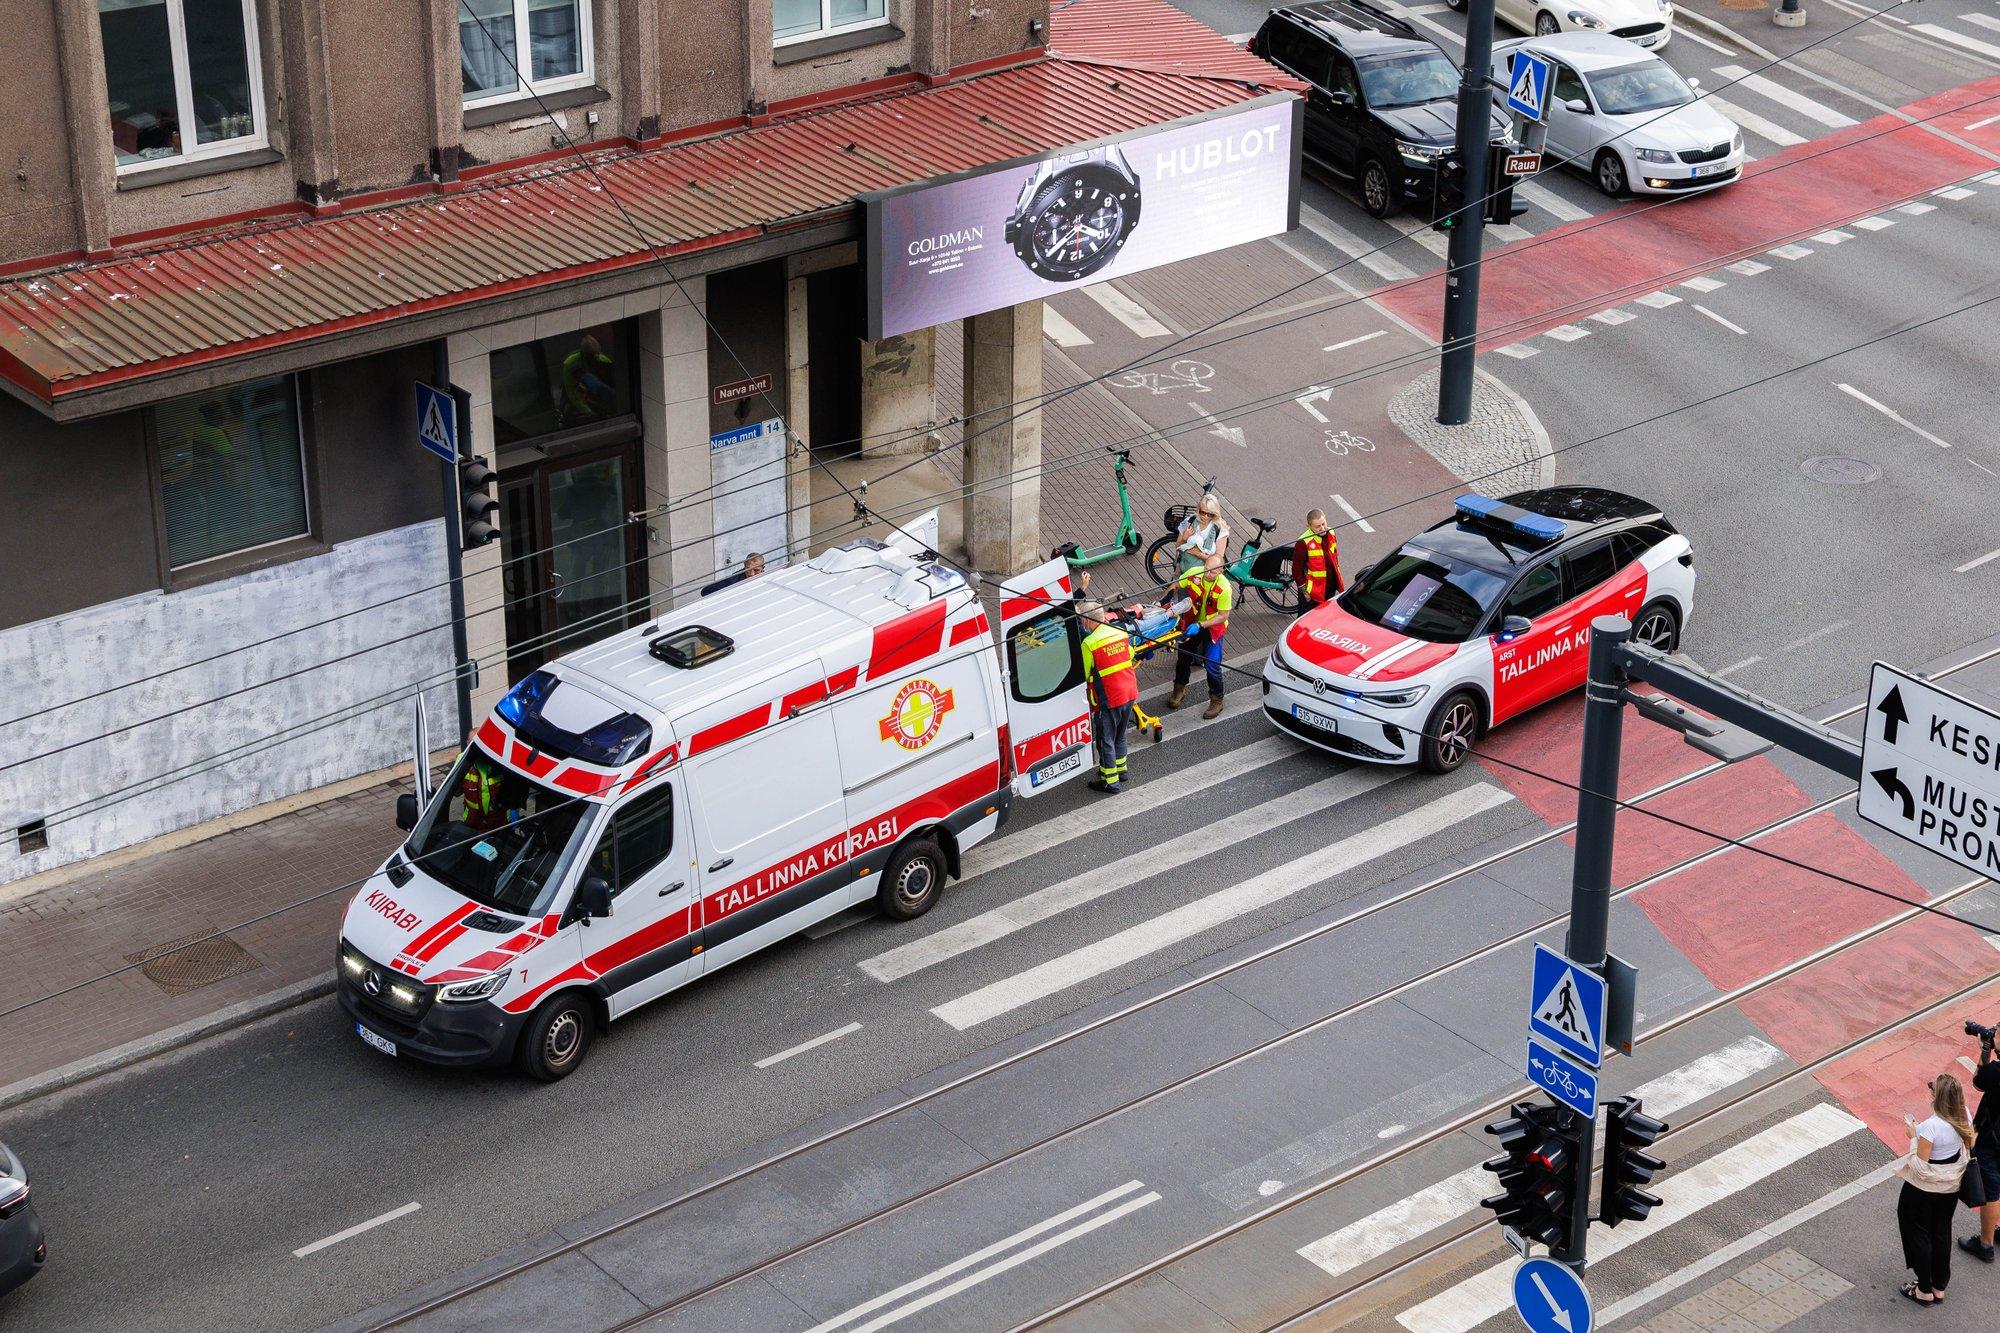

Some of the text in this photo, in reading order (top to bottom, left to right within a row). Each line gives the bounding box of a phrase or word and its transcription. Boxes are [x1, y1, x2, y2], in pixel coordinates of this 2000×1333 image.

[1156, 124, 1281, 181] HUBLOT
[1510, 160, 1536, 171] Raua
[908, 225, 983, 256] GOLDMAN
[720, 379, 767, 399] Narva mnt
[710, 422, 780, 450] Narva mnt 14
[1499, 648, 1516, 662] ARST
[1500, 637, 1572, 683] TALLINNA
[891, 680, 936, 712] TALLINNA
[1298, 707, 1334, 730] 515 GXW
[899, 722, 940, 749] KIIRABI
[1020, 719, 1091, 757] 7 KIIR
[1930, 714, 2000, 772] KES
[1038, 755, 1077, 781] 363 GKS
[823, 816, 899, 866] KIIRABI
[715, 854, 819, 914] TALLINNA
[364, 889, 423, 933] KIIRABI
[520, 969, 529, 984] 7
[377, 1037, 395, 1053] GKS
